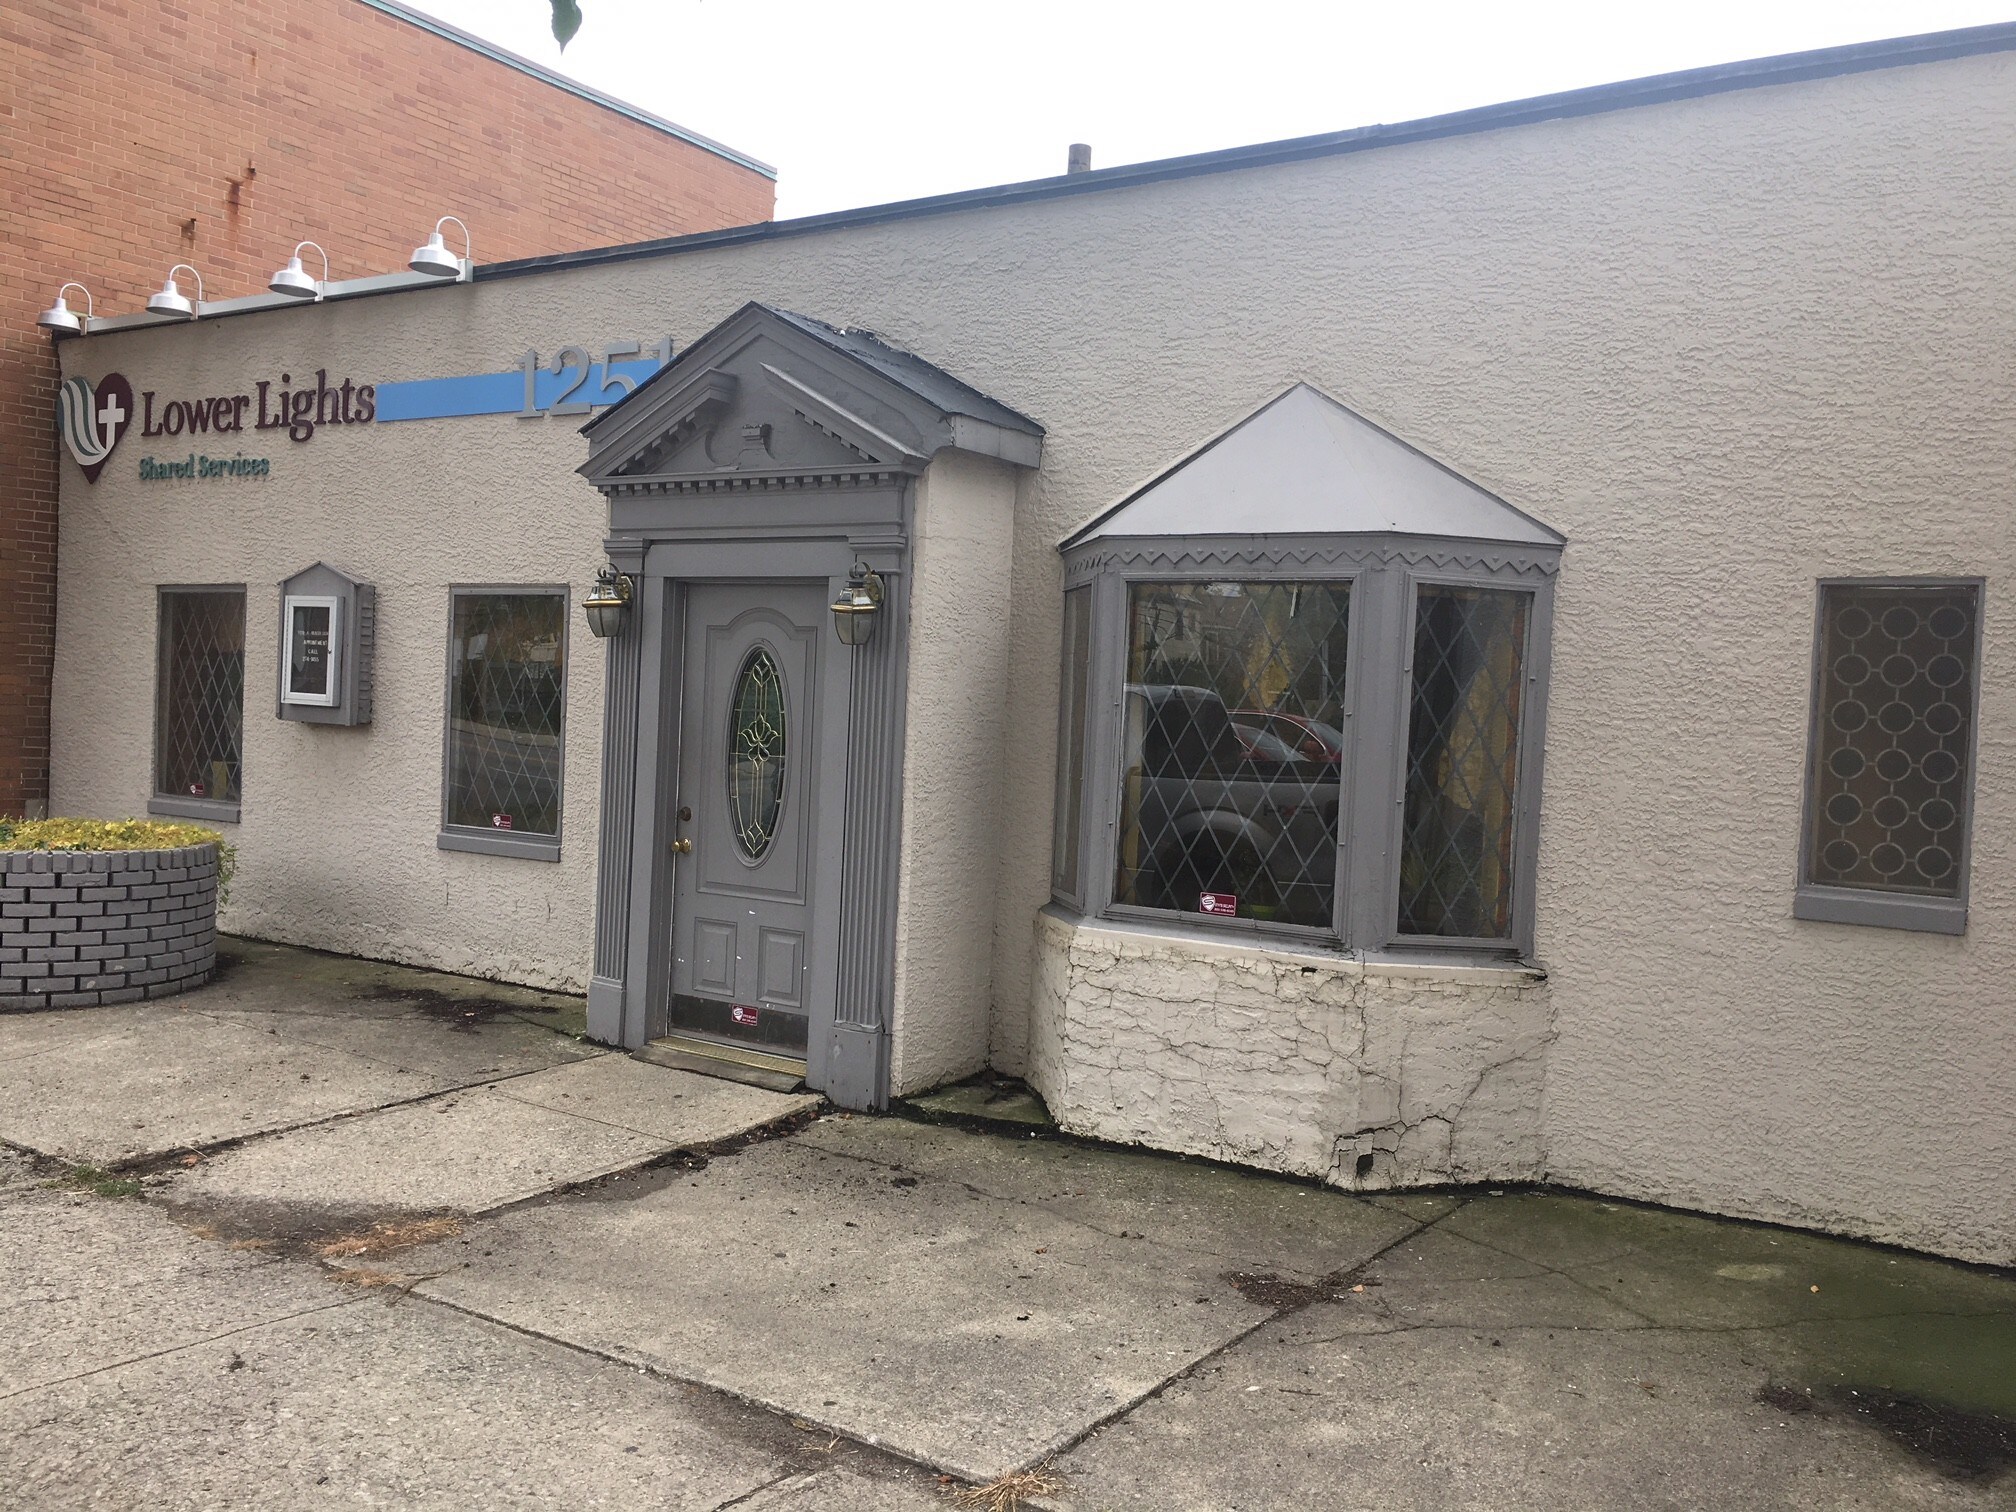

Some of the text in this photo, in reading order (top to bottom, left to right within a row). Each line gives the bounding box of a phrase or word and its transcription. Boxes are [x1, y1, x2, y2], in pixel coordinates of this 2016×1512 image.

[140, 368, 375, 442] Lower Lights
[138, 451, 270, 480] Shared Services
